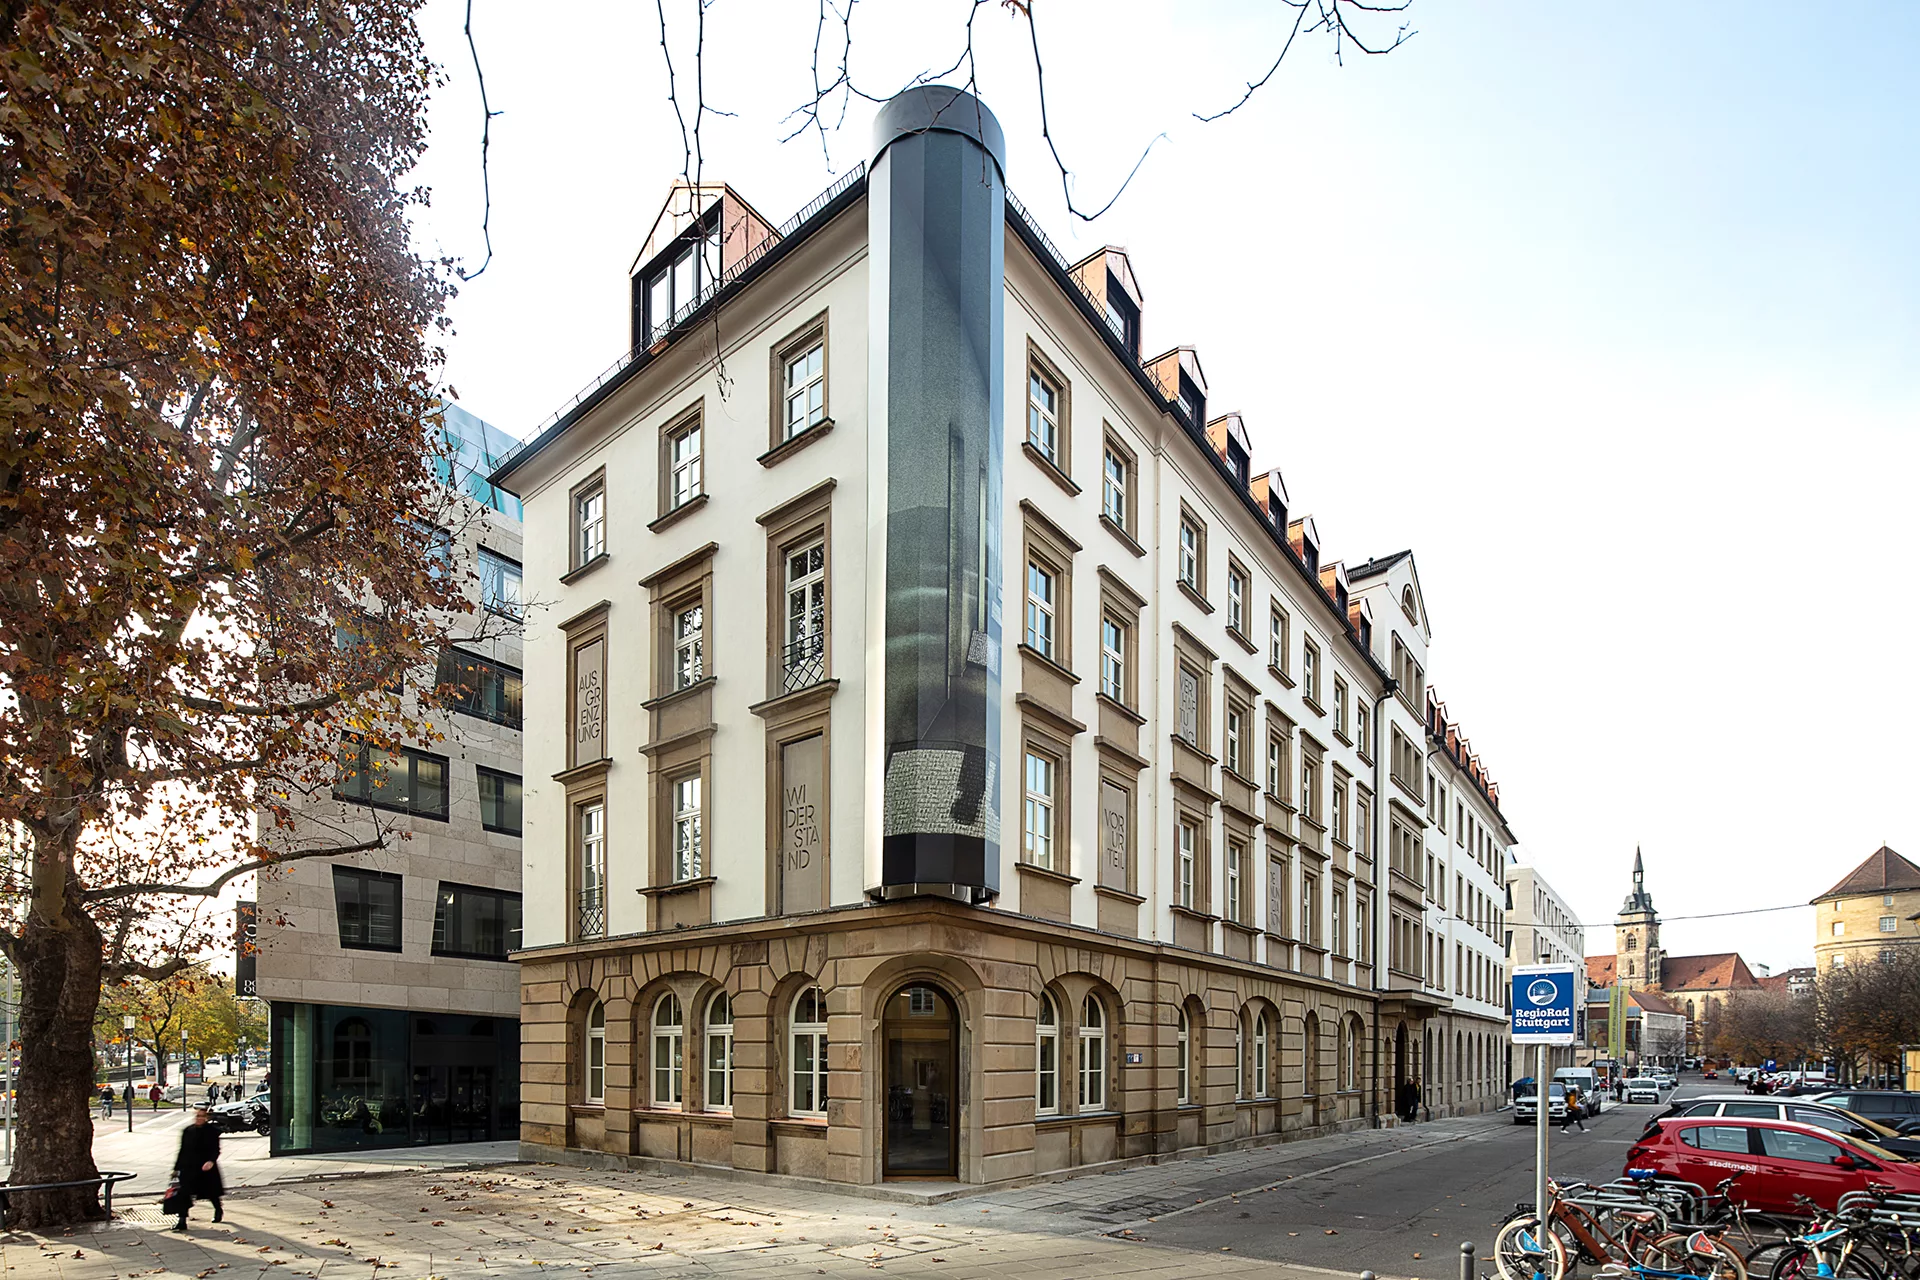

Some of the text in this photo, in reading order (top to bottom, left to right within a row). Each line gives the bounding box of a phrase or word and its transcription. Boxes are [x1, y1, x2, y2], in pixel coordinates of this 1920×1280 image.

[579, 670, 597, 693] AUS
[586, 687, 600, 707] GR
[580, 704, 600, 726] ENZ
[578, 722, 600, 744] UNG
[786, 784, 806, 806] WI
[786, 804, 814, 828] DER
[1104, 808, 1124, 832] VOR
[794, 826, 820, 848] STA
[1112, 831, 1124, 851] UR
[788, 850, 810, 872] ND
[1515, 1018, 1570, 1028] Stuttgart
[1516, 1008, 1570, 1020] RegioRad
[1708, 1160, 1757, 1172] stadtmobil
